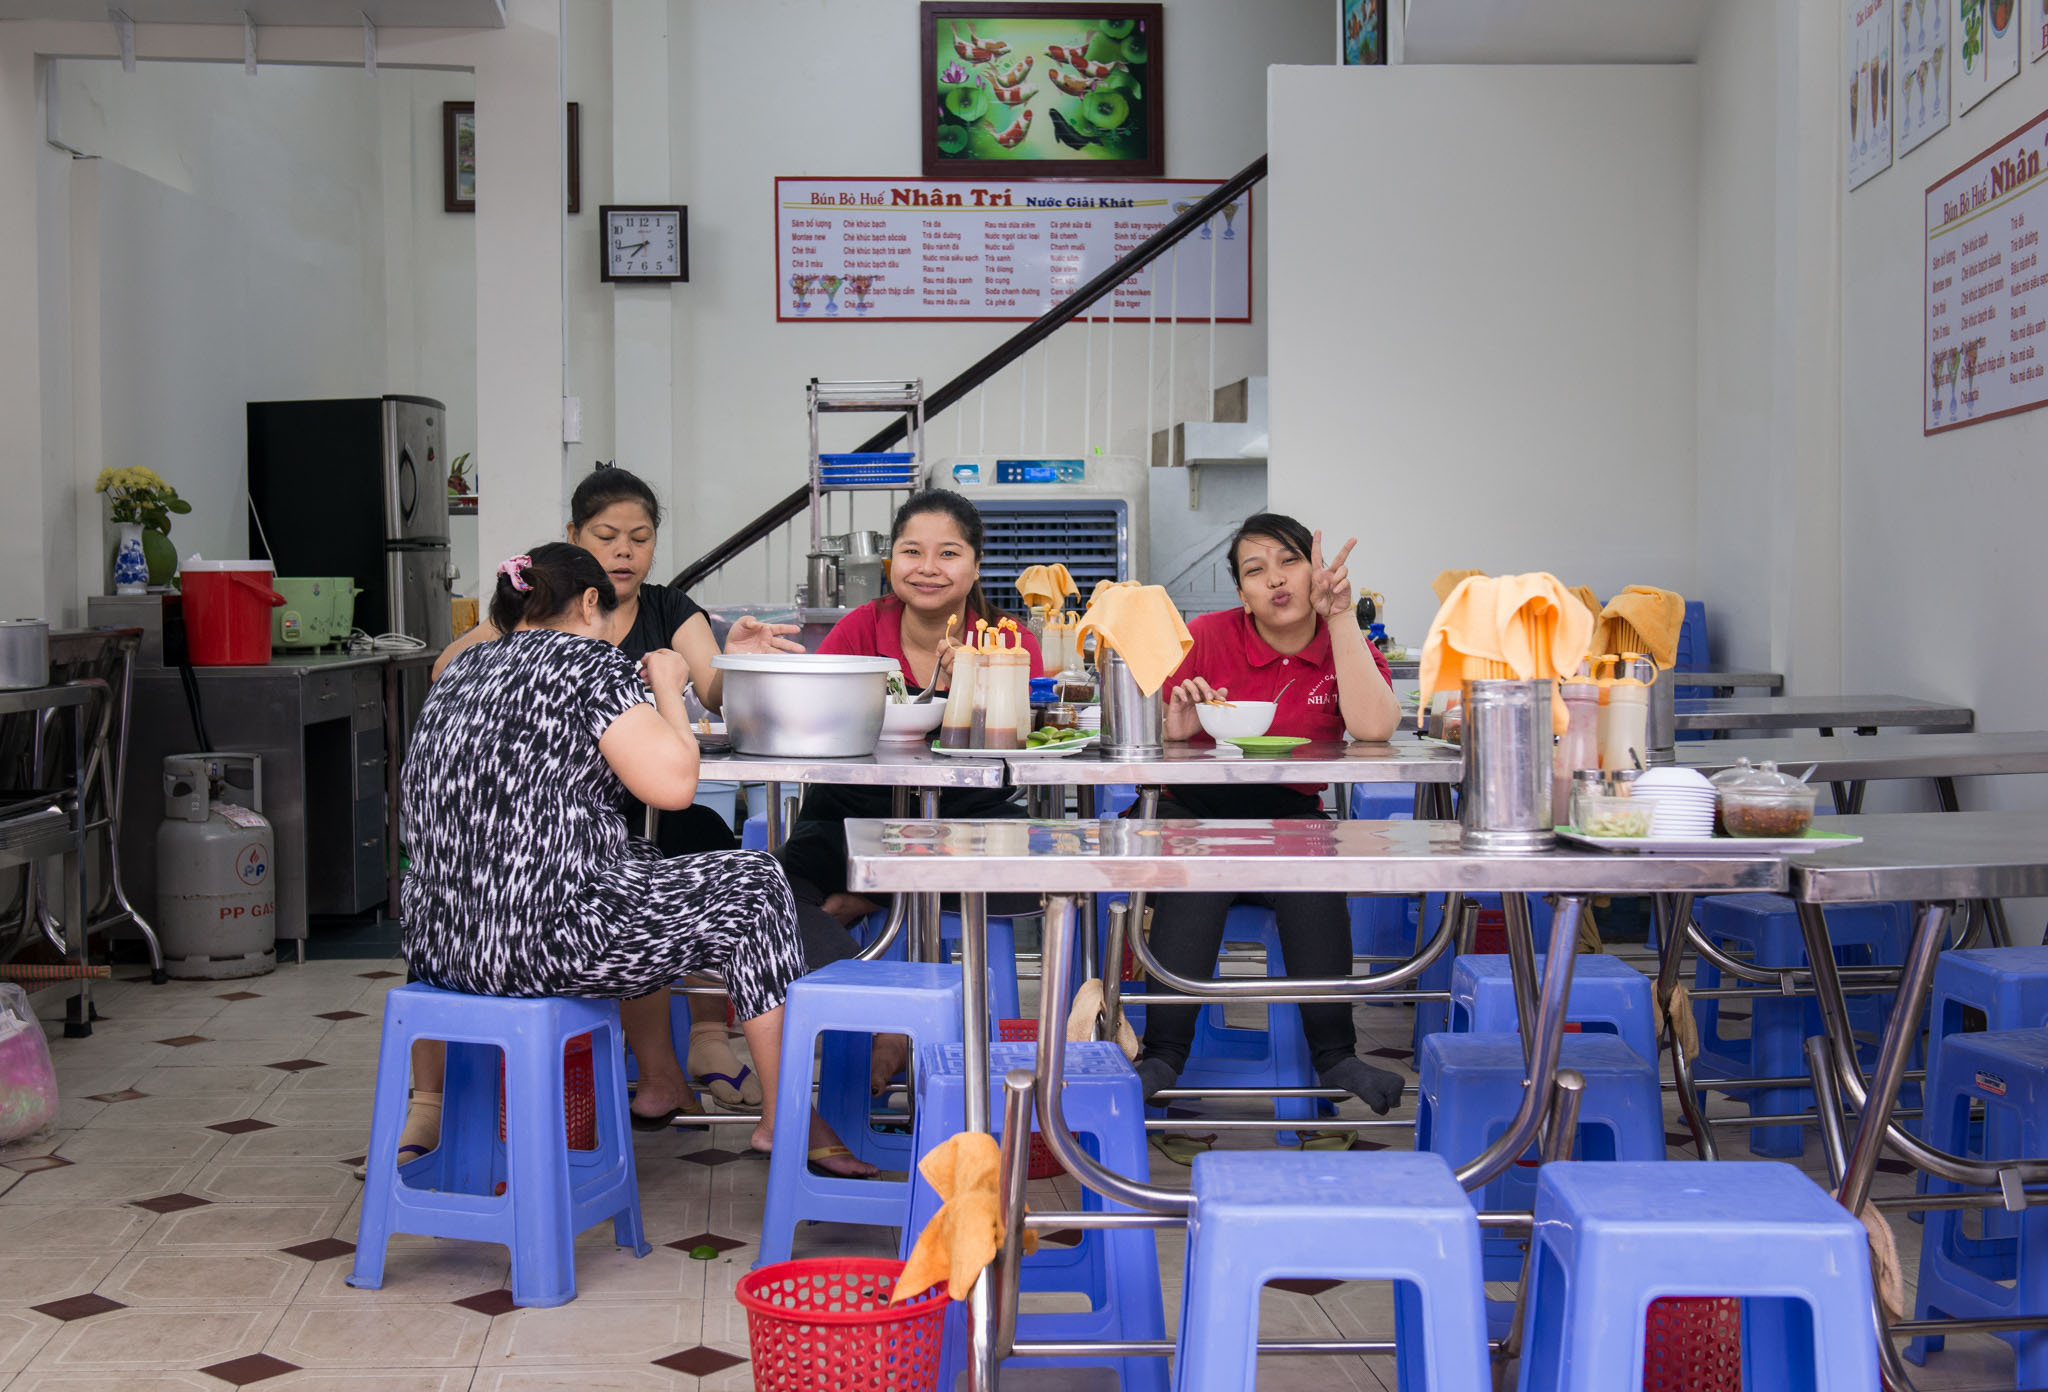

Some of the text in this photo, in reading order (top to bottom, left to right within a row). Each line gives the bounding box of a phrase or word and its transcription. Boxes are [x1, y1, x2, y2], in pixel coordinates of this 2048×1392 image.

[1944, 147, 2040, 225] Bún Bò Huế Nhân
[811, 189, 1134, 209] Bún Bò Huế Nhân Trí Nước Giải Khát
[626, 217, 634, 227] 11
[639, 217, 649, 227] 12
[656, 217, 660, 227] 1
[614, 225, 623, 235] 10
[667, 225, 674, 234] 2
[667, 239, 674, 249] 3
[615, 254, 622, 262] 8
[667, 254, 673, 262] 4
[626, 261, 633, 270] 7
[641, 261, 648, 271] 6
[656, 261, 663, 271] 5
[220, 901, 276, 920] PP GAS
